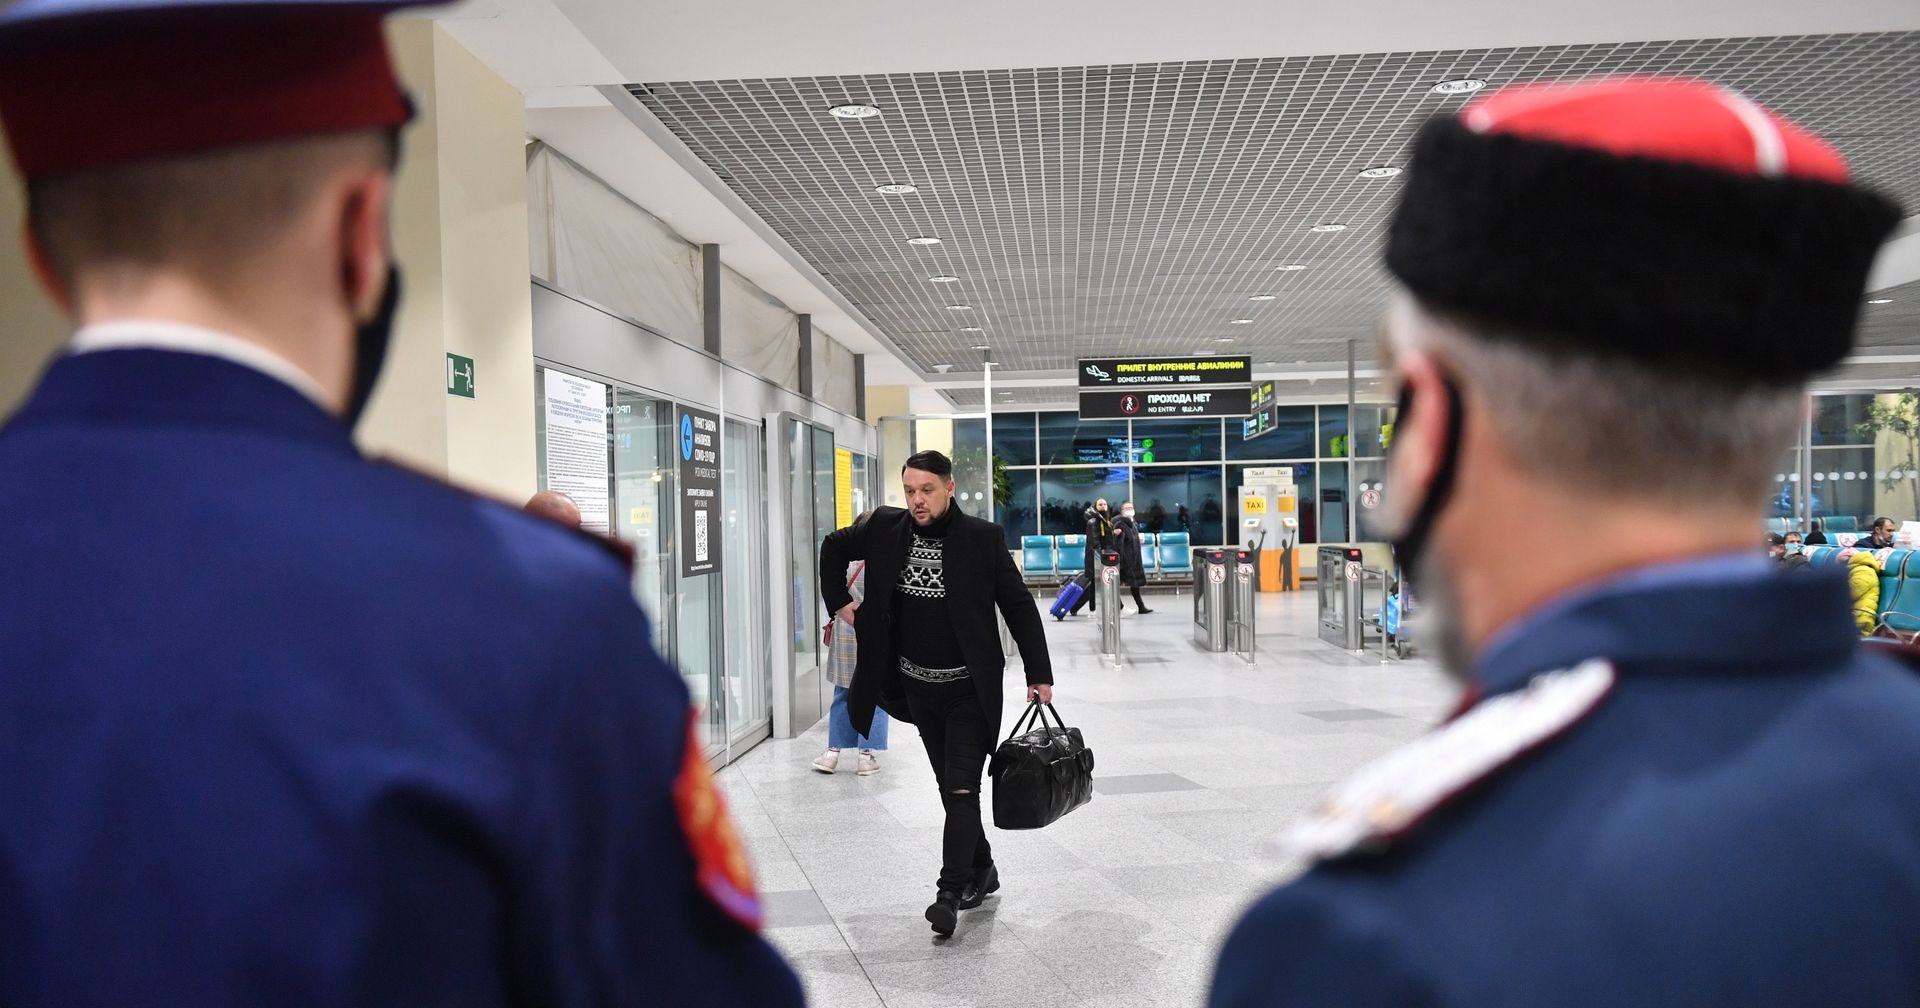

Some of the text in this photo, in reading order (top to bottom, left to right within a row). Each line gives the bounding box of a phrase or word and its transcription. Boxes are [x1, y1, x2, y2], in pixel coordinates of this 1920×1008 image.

[1117, 361, 1244, 372] ПРИЛЕТ ВНУТРЕННИЕ АВИАЛИНИИ
[1148, 393, 1211, 404] ПРОХОДА НЕТ
[1246, 501, 1264, 509] TAXI
